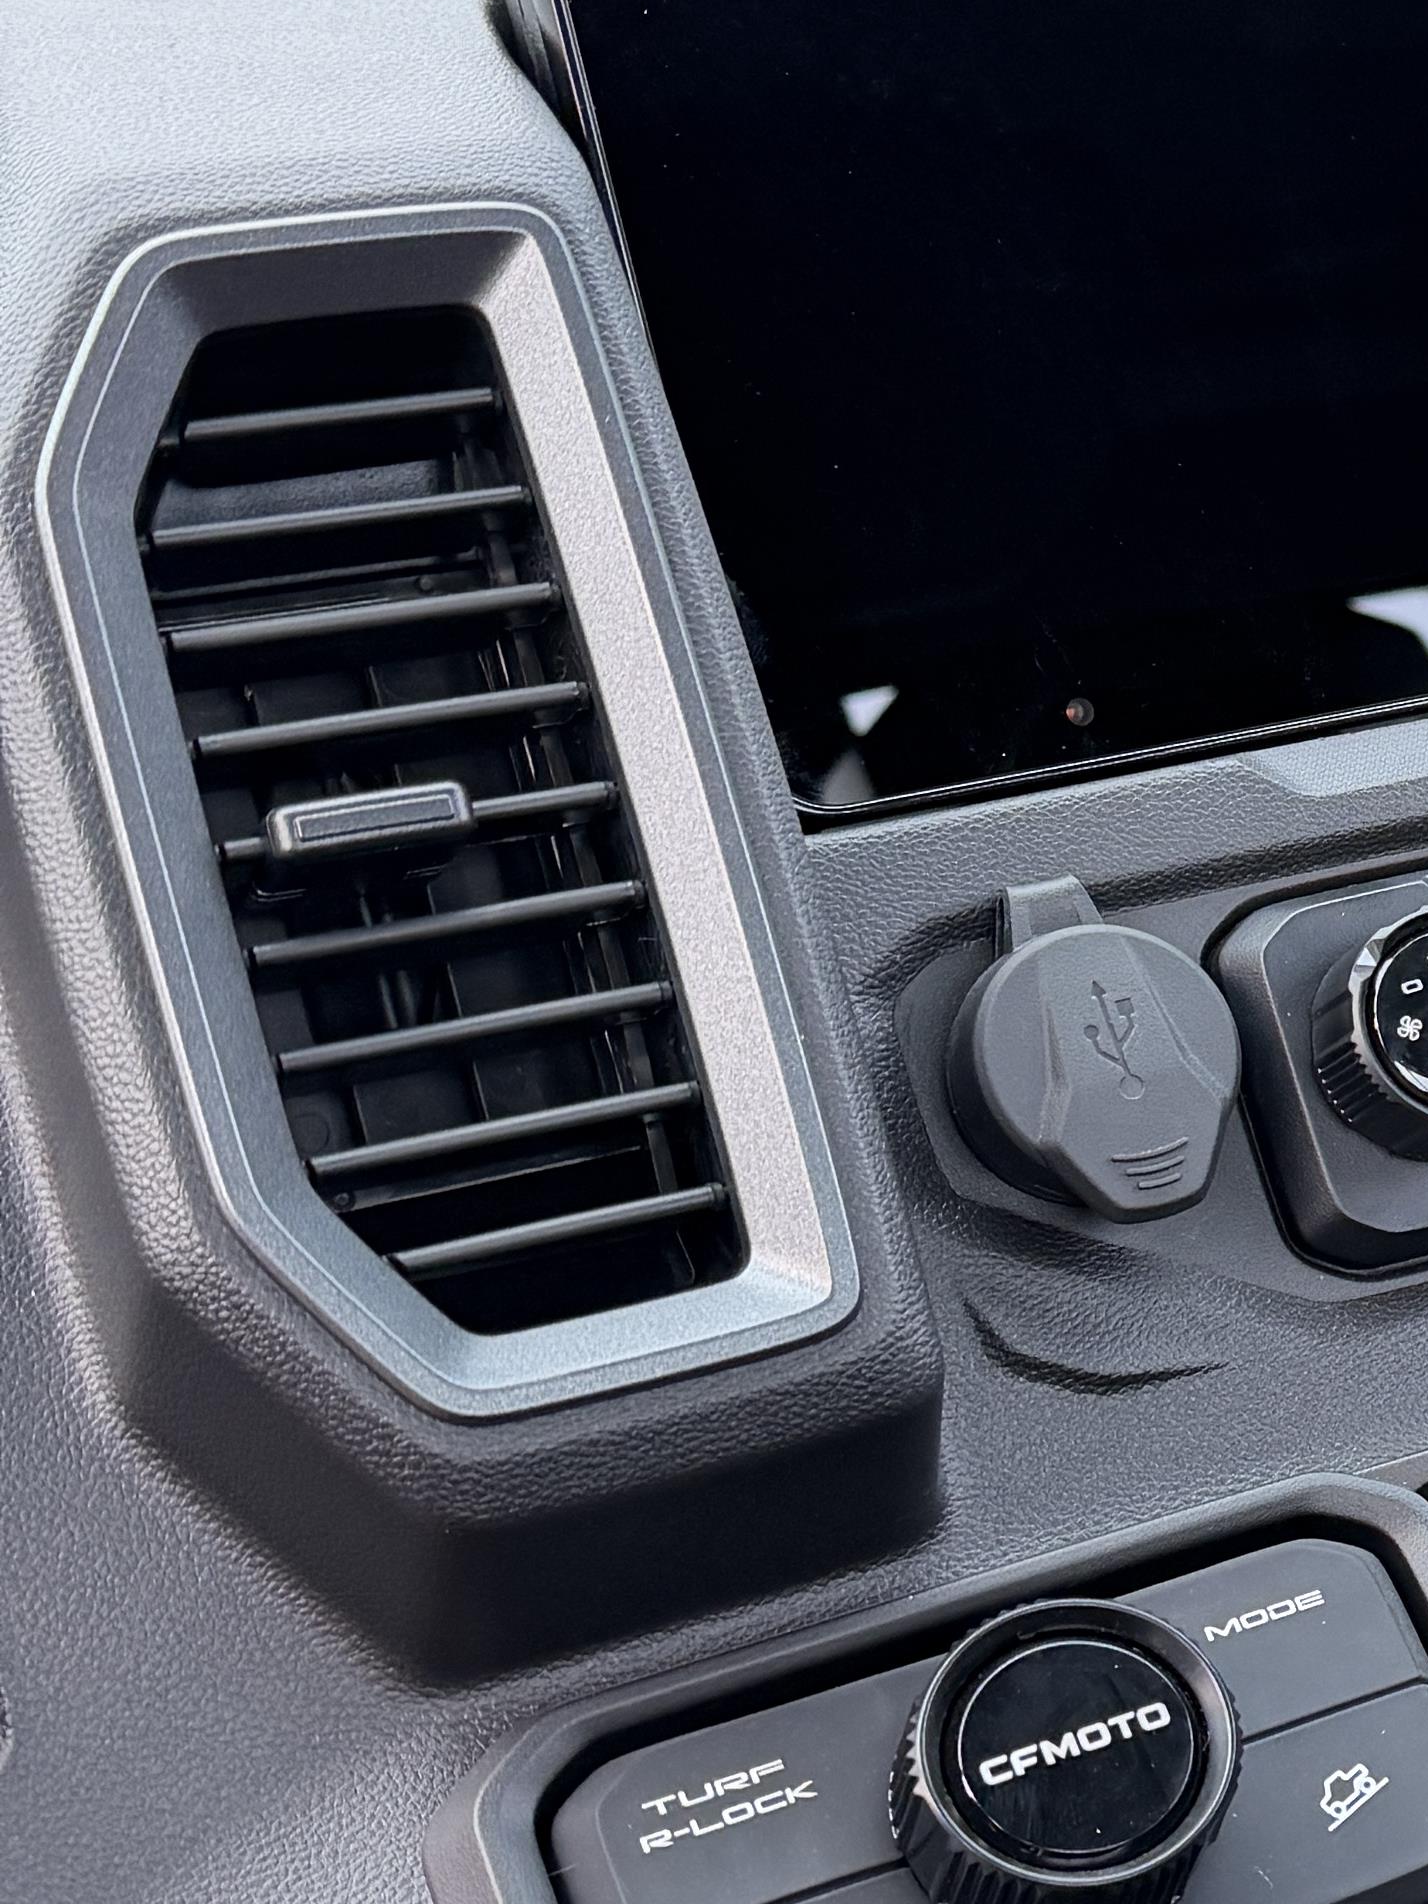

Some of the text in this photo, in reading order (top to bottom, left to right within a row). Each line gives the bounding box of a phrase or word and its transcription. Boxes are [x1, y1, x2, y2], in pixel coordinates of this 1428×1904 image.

[1203, 1589, 1326, 1643] MODE
[978, 1701, 1172, 1787] CFMOTO
[639, 1779, 818, 1854] R-LOCK
[641, 1758, 785, 1816] TURF
